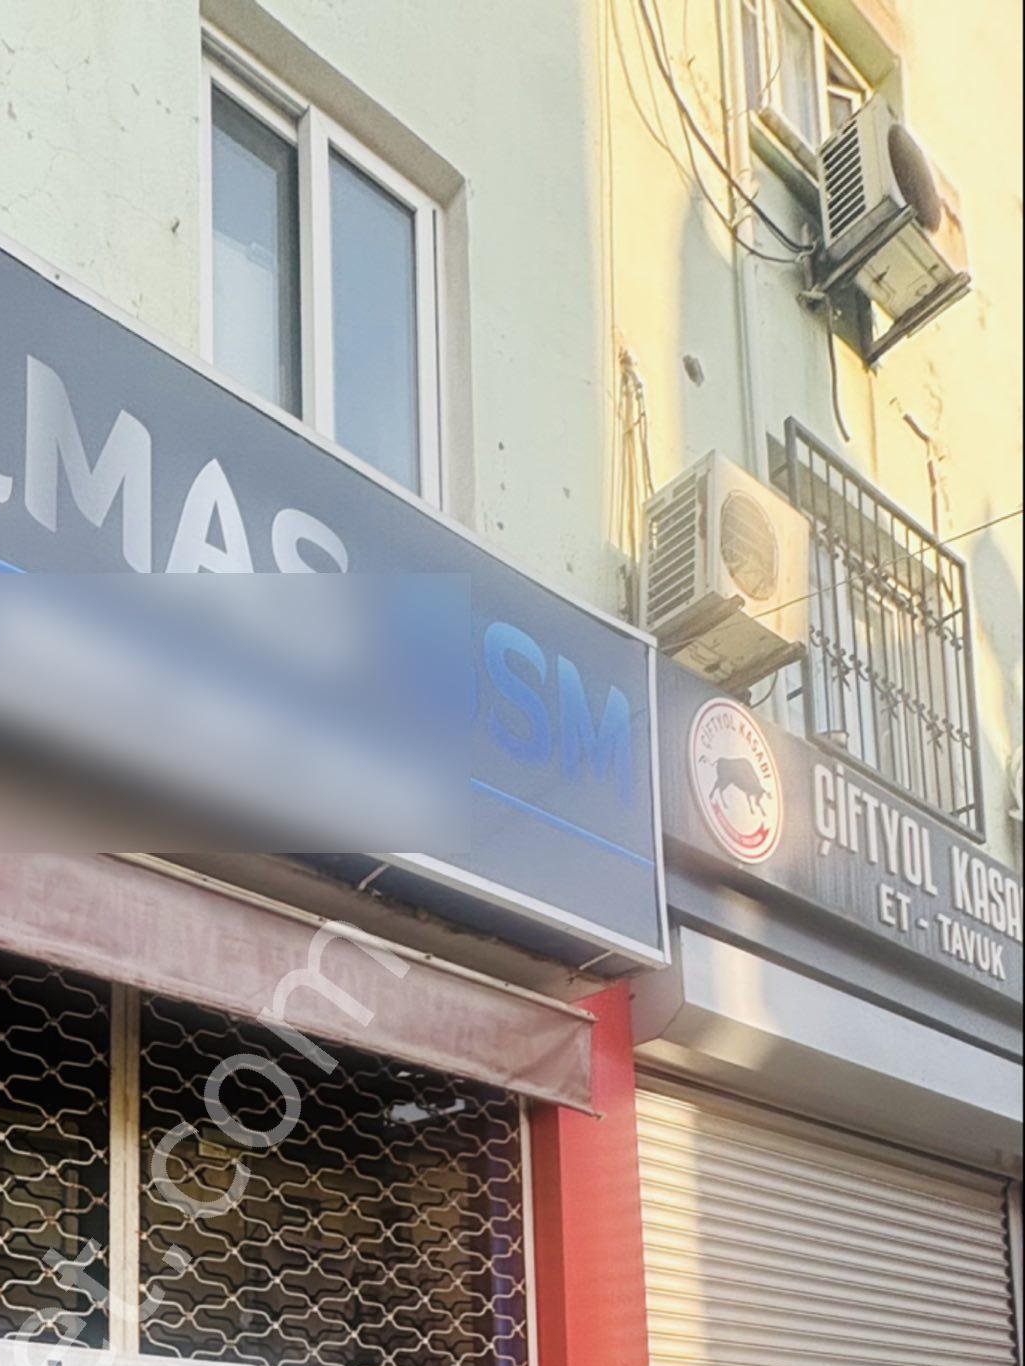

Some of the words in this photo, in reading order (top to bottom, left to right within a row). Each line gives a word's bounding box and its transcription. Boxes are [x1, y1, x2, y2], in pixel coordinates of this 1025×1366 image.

[482, 620, 636, 814] SM
[814, 763, 938, 896] ÇİFTYOL
[951, 845, 1023, 943] KASA
[879, 882, 912, 933] ET
[936, 912, 1005, 981] TAVUK
